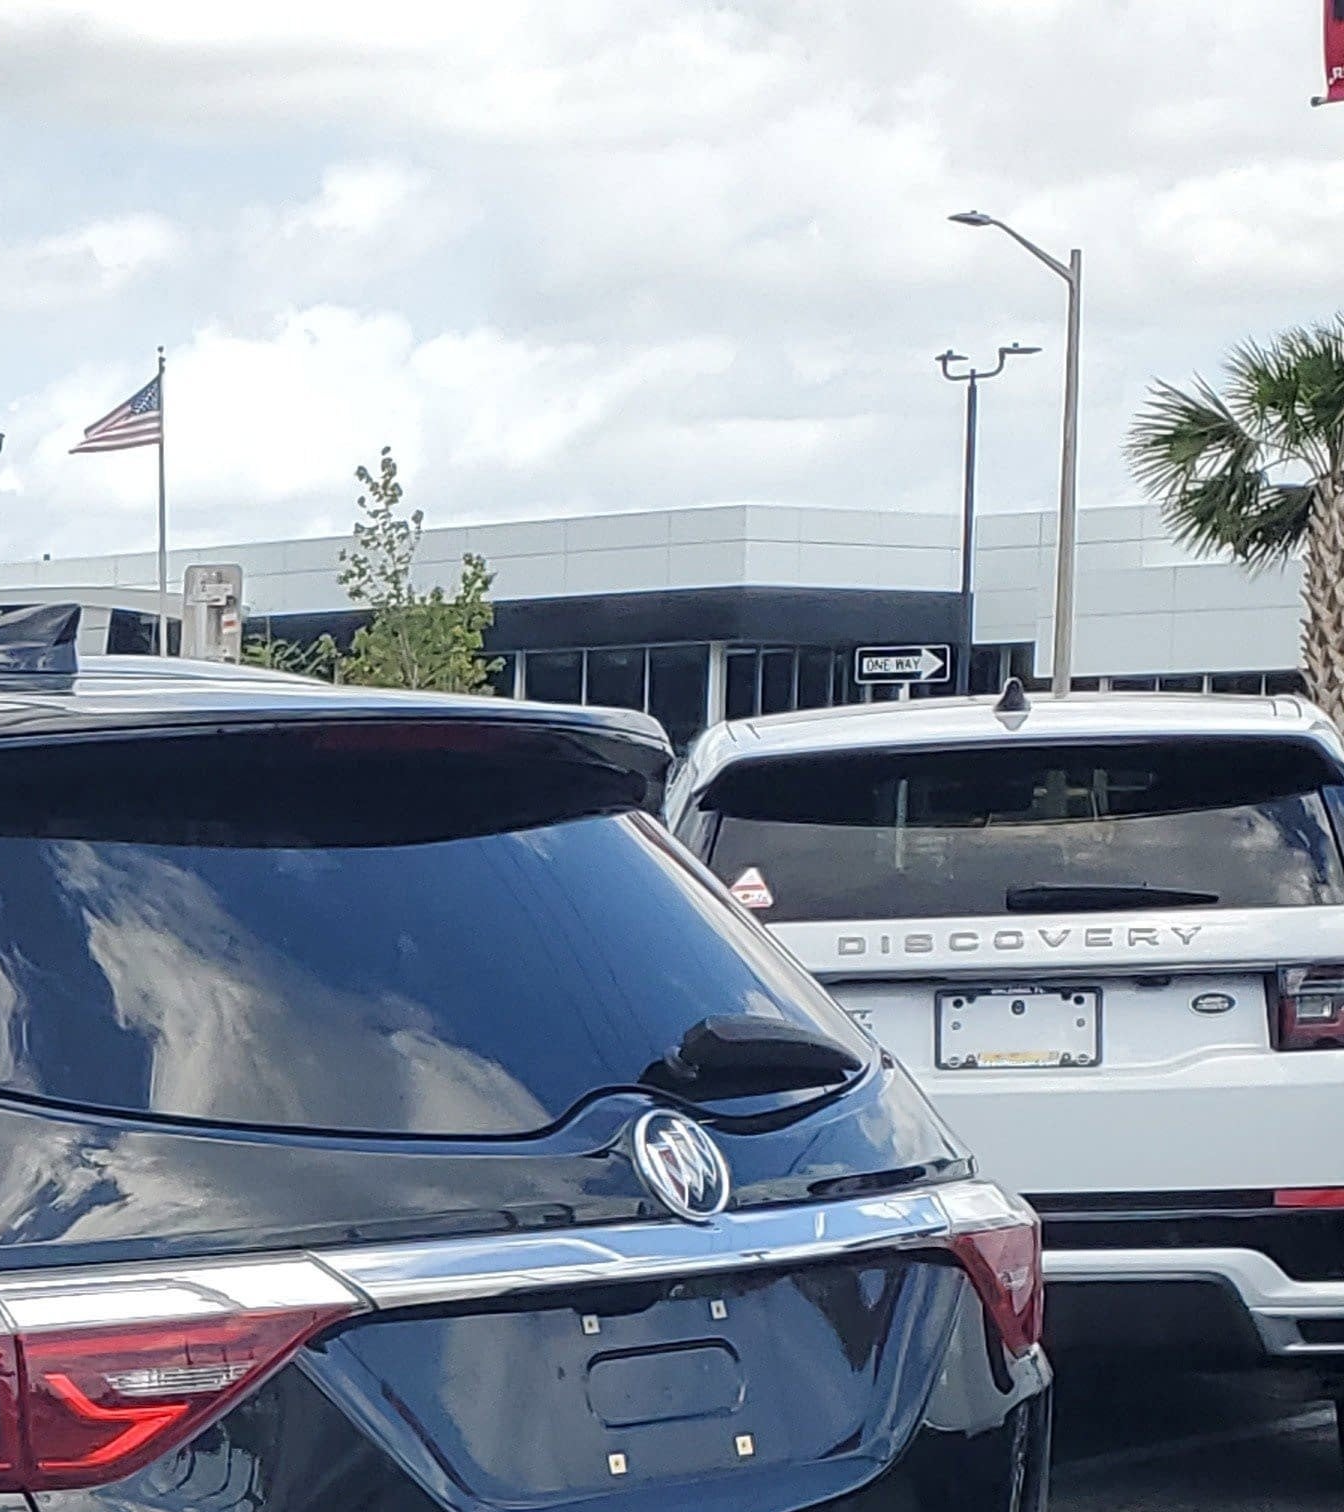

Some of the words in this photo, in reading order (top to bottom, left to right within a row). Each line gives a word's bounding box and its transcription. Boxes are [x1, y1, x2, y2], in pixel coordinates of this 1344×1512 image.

[866, 658, 891, 672] ONE
[895, 657, 921, 671] WAY
[837, 925, 1202, 956] DISCOVERY
